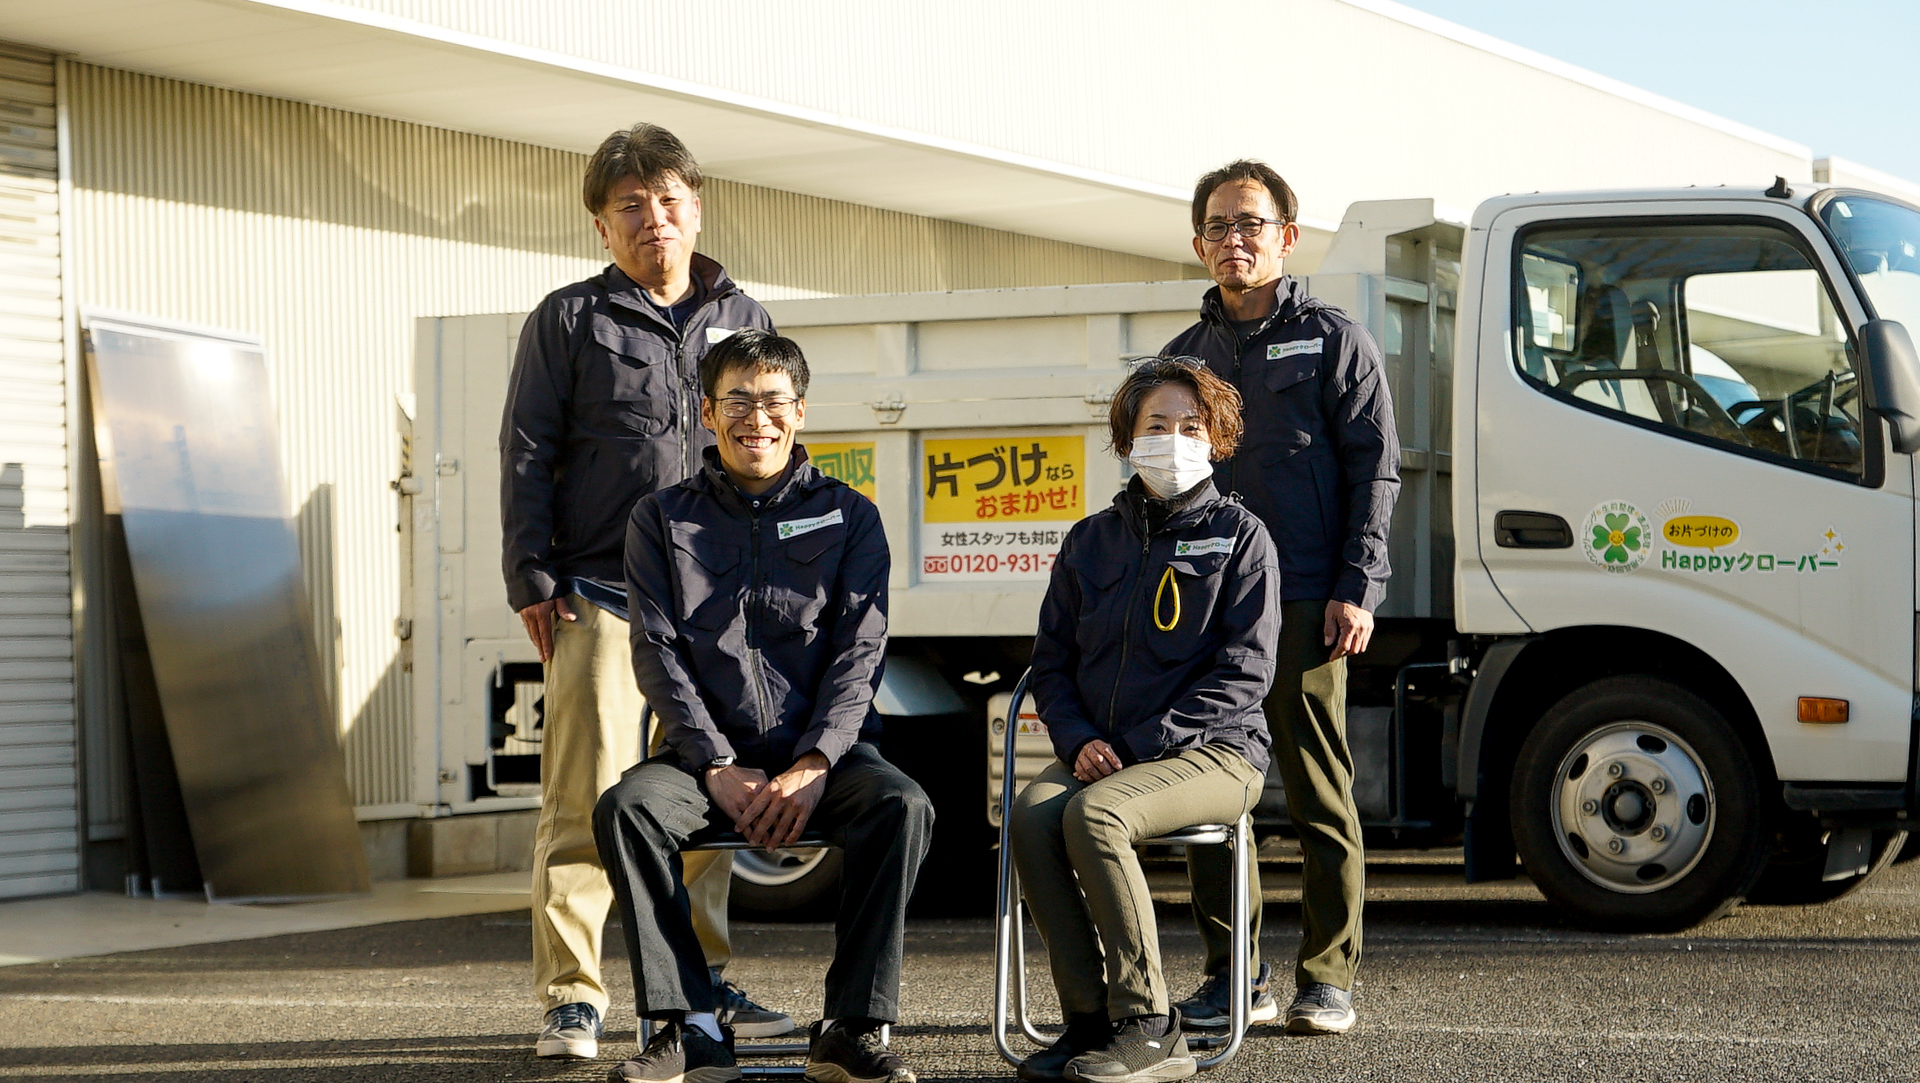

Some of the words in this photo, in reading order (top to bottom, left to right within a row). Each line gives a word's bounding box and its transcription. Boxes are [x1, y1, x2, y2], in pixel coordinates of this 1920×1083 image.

[812, 447, 875, 487] 回収
[926, 442, 1075, 499] 片づけなら
[975, 484, 1078, 519] おまかせ!
[1668, 524, 1733, 538] お片づけの
[1662, 550, 1839, 573] Happyクローバー
